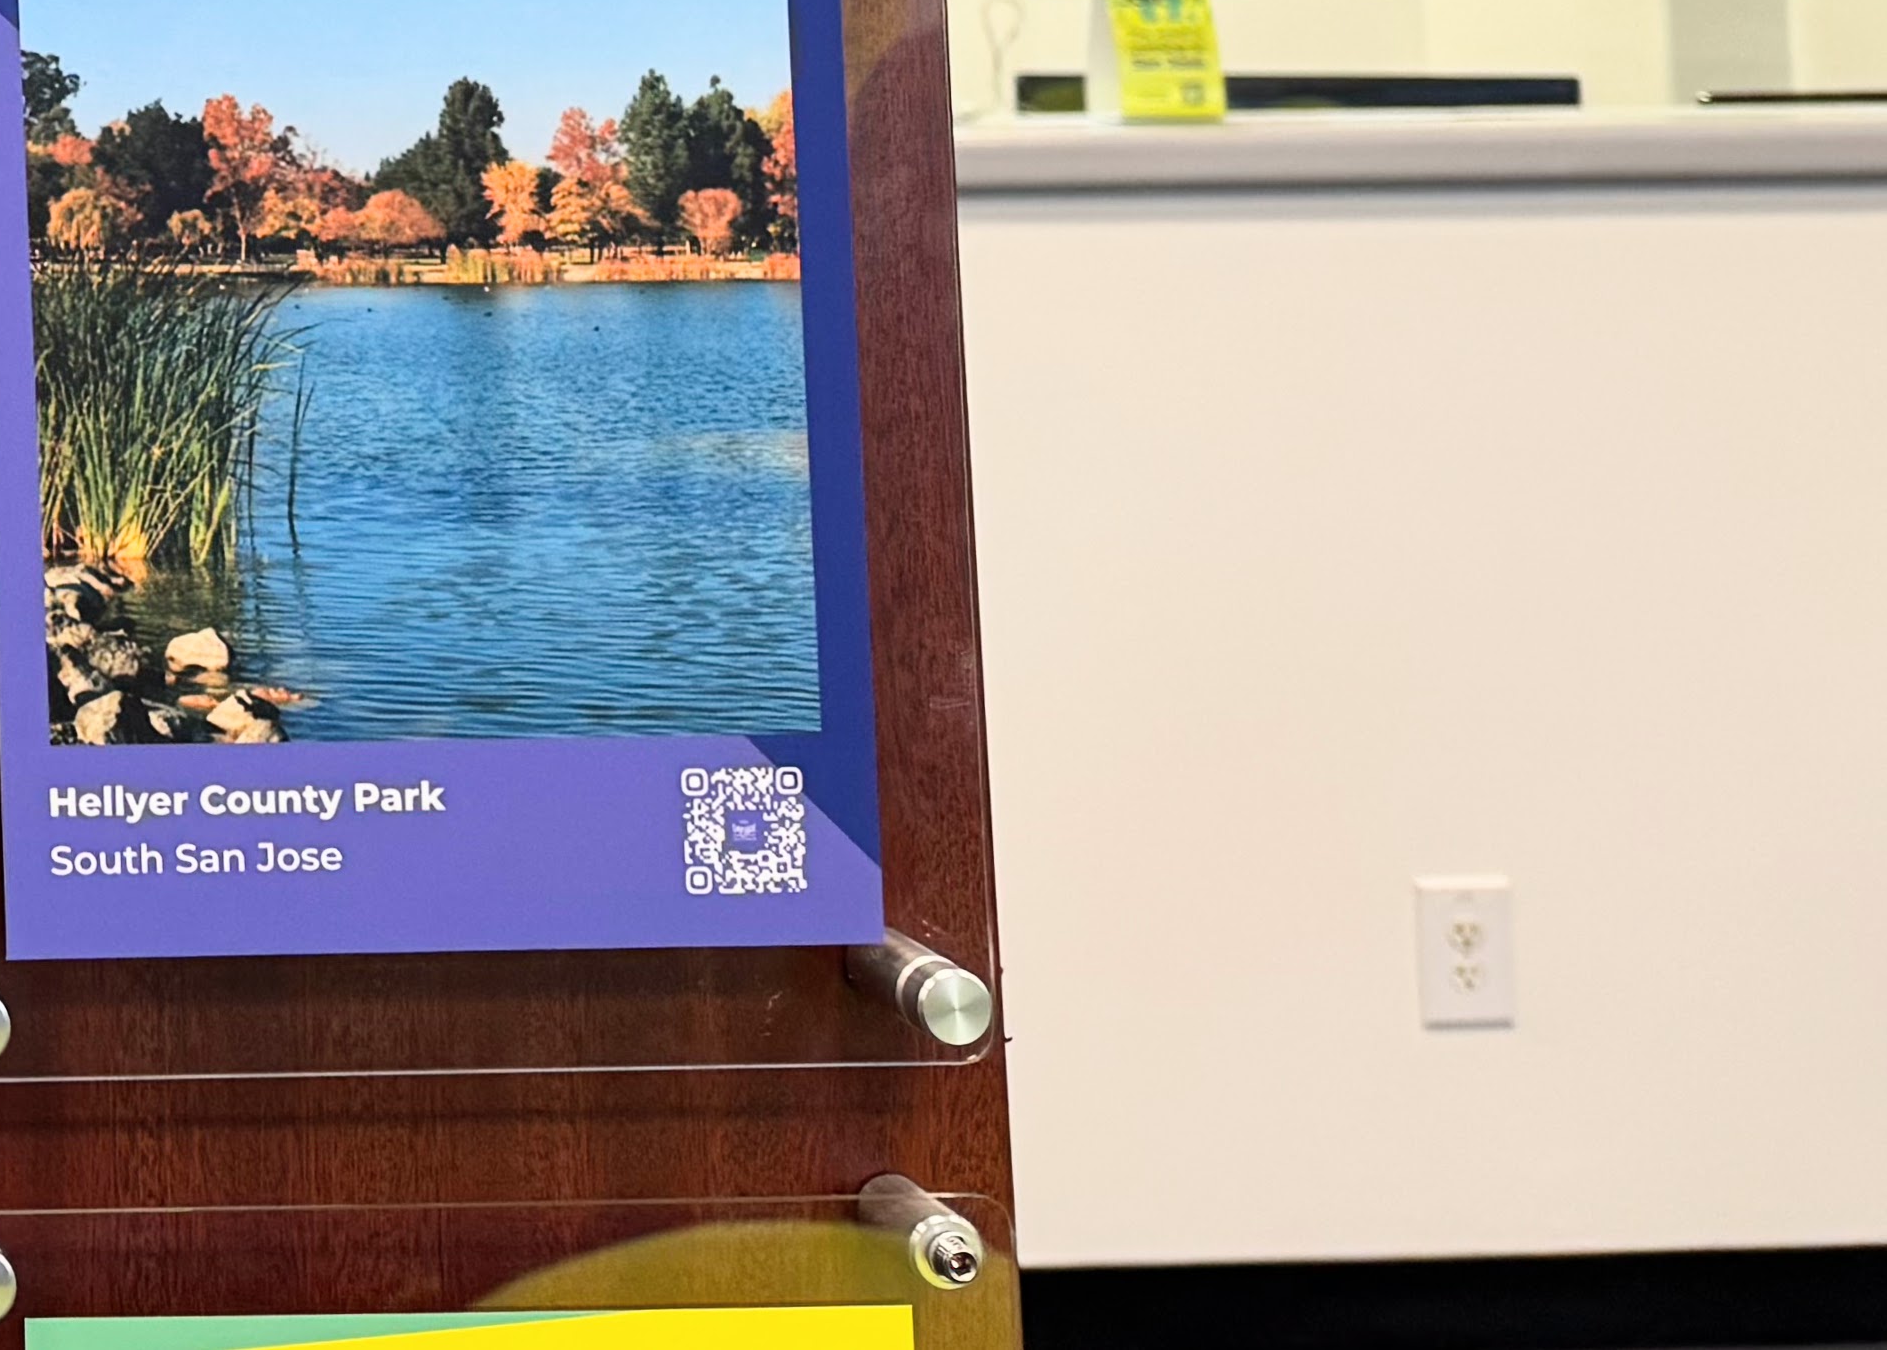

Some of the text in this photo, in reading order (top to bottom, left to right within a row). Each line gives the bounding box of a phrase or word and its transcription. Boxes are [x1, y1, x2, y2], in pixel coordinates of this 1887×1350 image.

[49, 780, 446, 824] Hellyer County Park
[50, 843, 344, 876] South San Jose
